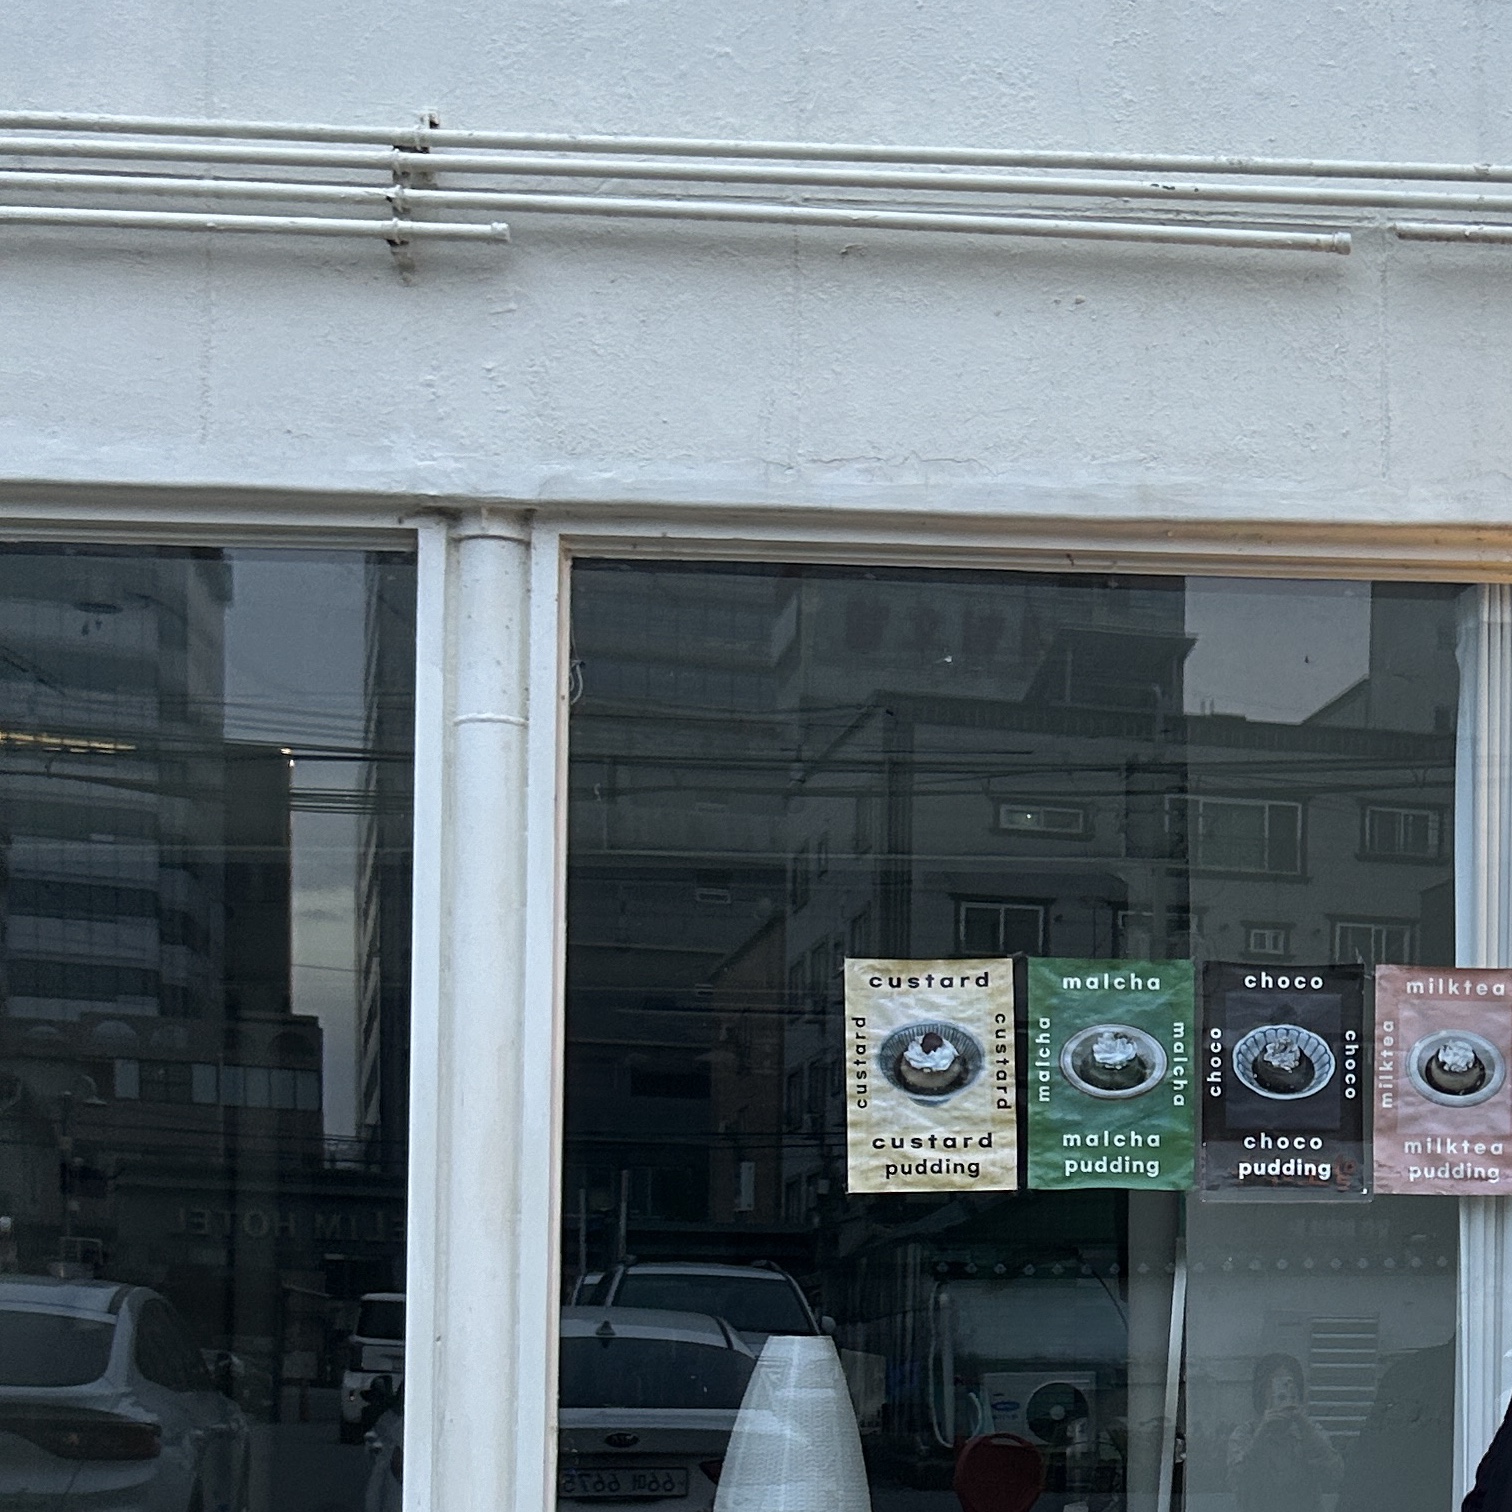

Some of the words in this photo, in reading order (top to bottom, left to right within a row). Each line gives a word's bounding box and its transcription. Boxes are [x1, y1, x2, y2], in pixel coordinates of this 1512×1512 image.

[869, 972, 989, 989] custard
[1244, 972, 1324, 991] choco
[1406, 978, 1506, 996] milktea
[852, 1017, 868, 1109] custard
[994, 1013, 1012, 1109] custard
[1207, 1027, 1222, 1097] choco
[1345, 1030, 1359, 1100] choco
[1378, 1020, 1395, 1109] milktea
[872, 1132, 993, 1149] custard
[1243, 1133, 1323, 1150] choco
[1404, 1137, 1504, 1155] milktea
[885, 1158, 980, 1179] pudding
[1064, 1157, 1160, 1177] pudding
[1238, 1159, 1332, 1179] pudding
[1409, 1163, 1500, 1183] pudding
